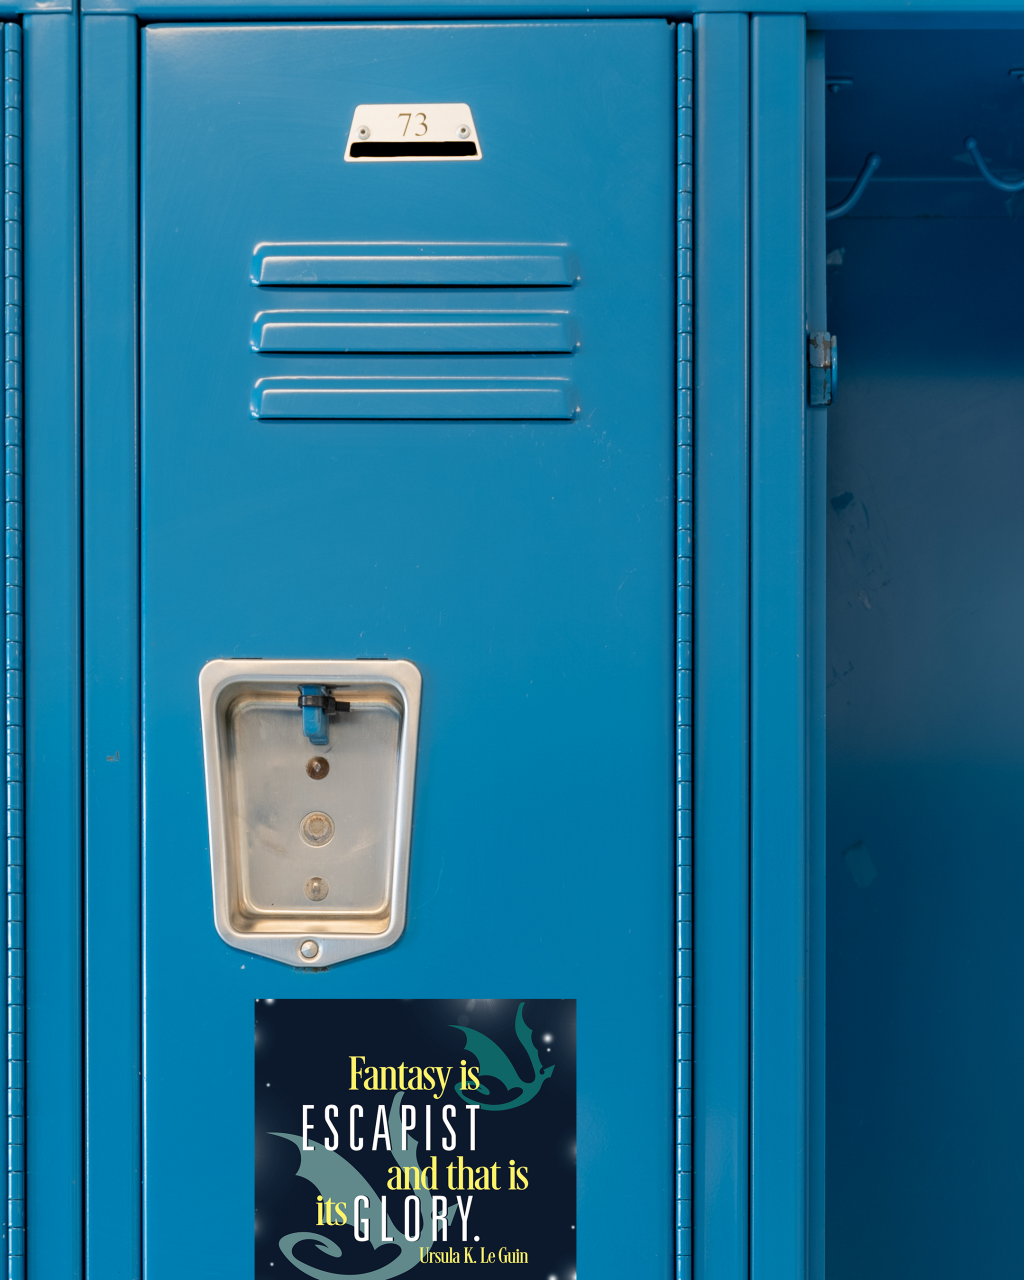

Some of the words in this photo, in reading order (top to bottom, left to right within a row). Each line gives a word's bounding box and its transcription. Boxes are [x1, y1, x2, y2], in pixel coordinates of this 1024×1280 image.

[397, 112, 428, 137] 73
[348, 1055, 453, 1100] Fantasy
[459, 1059, 481, 1091] is
[301, 1104, 481, 1151] ESCAPIST
[386, 1155, 439, 1191] and
[445, 1155, 502, 1191] that
[507, 1159, 530, 1191] is
[315, 1194, 348, 1227] its
[353, 1195, 481, 1242] GLORY.
[419, 1246, 460, 1264] Ursula
[463, 1246, 477, 1264] K.
[480, 1246, 496, 1264] Le
[498, 1246, 529, 1264] Guin
